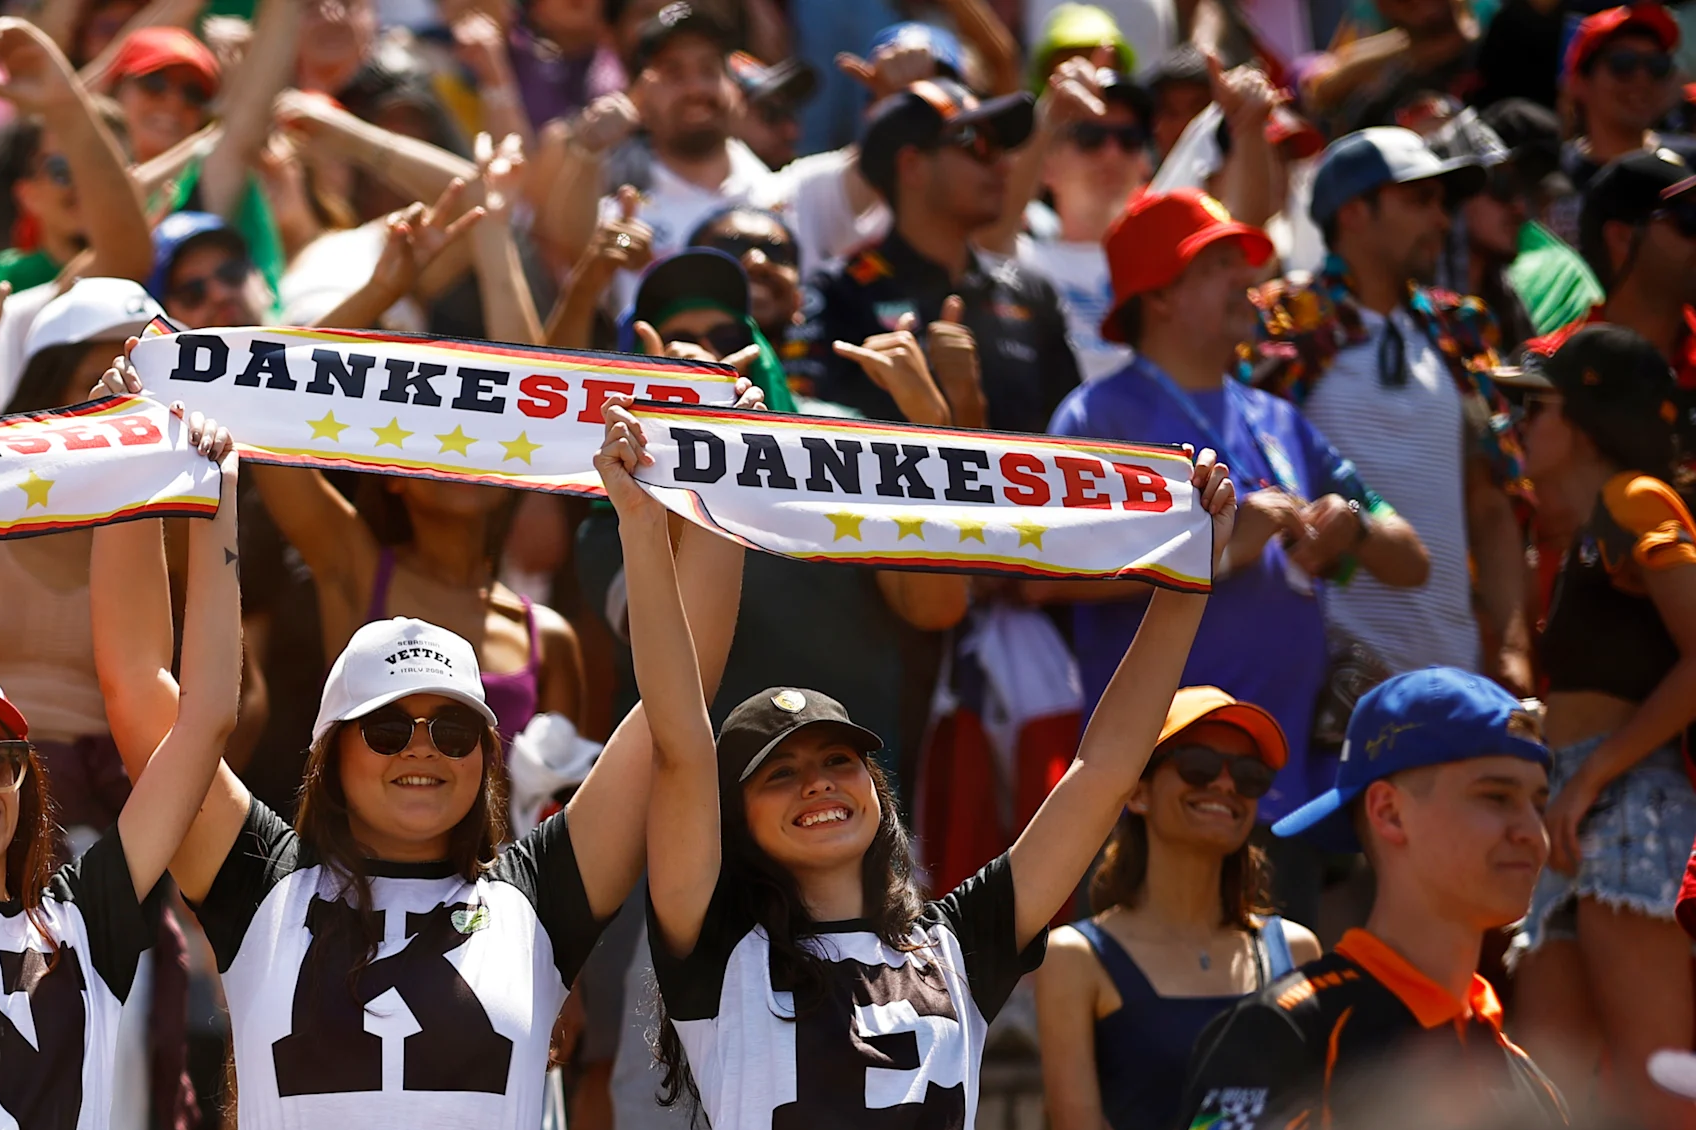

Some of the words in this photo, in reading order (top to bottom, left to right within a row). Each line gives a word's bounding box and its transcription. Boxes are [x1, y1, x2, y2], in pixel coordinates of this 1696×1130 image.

[670, 427, 1173, 513] DANKESEB
[385, 647, 453, 669] VETTEL
[272, 892, 514, 1098] K
